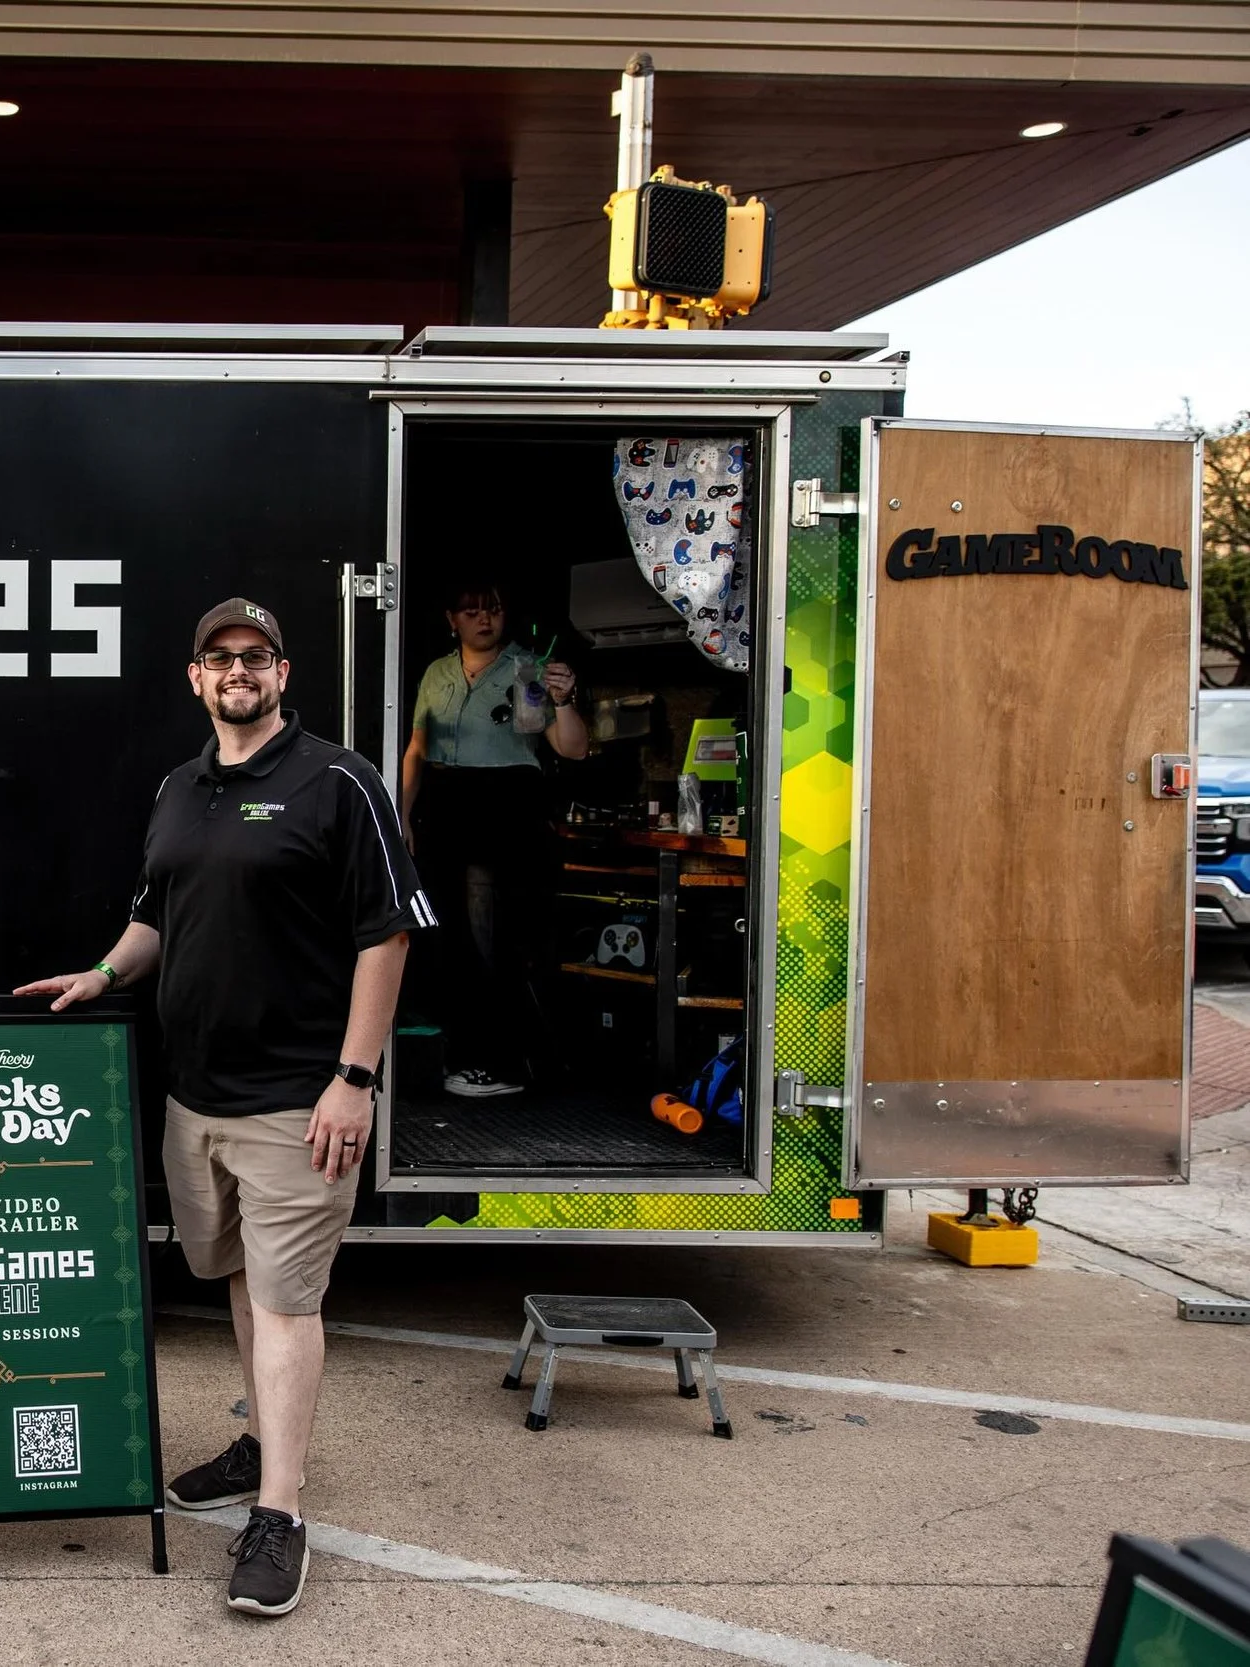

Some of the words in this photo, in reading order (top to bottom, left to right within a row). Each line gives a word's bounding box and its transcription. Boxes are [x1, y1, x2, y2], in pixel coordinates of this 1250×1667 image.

[245, 605, 266, 622] GG
[1, 1108, 91, 1146] Day
[2, 1326, 81, 1341] SESSIONS
[20, 1480, 78, 1491] INSTAGRAM
